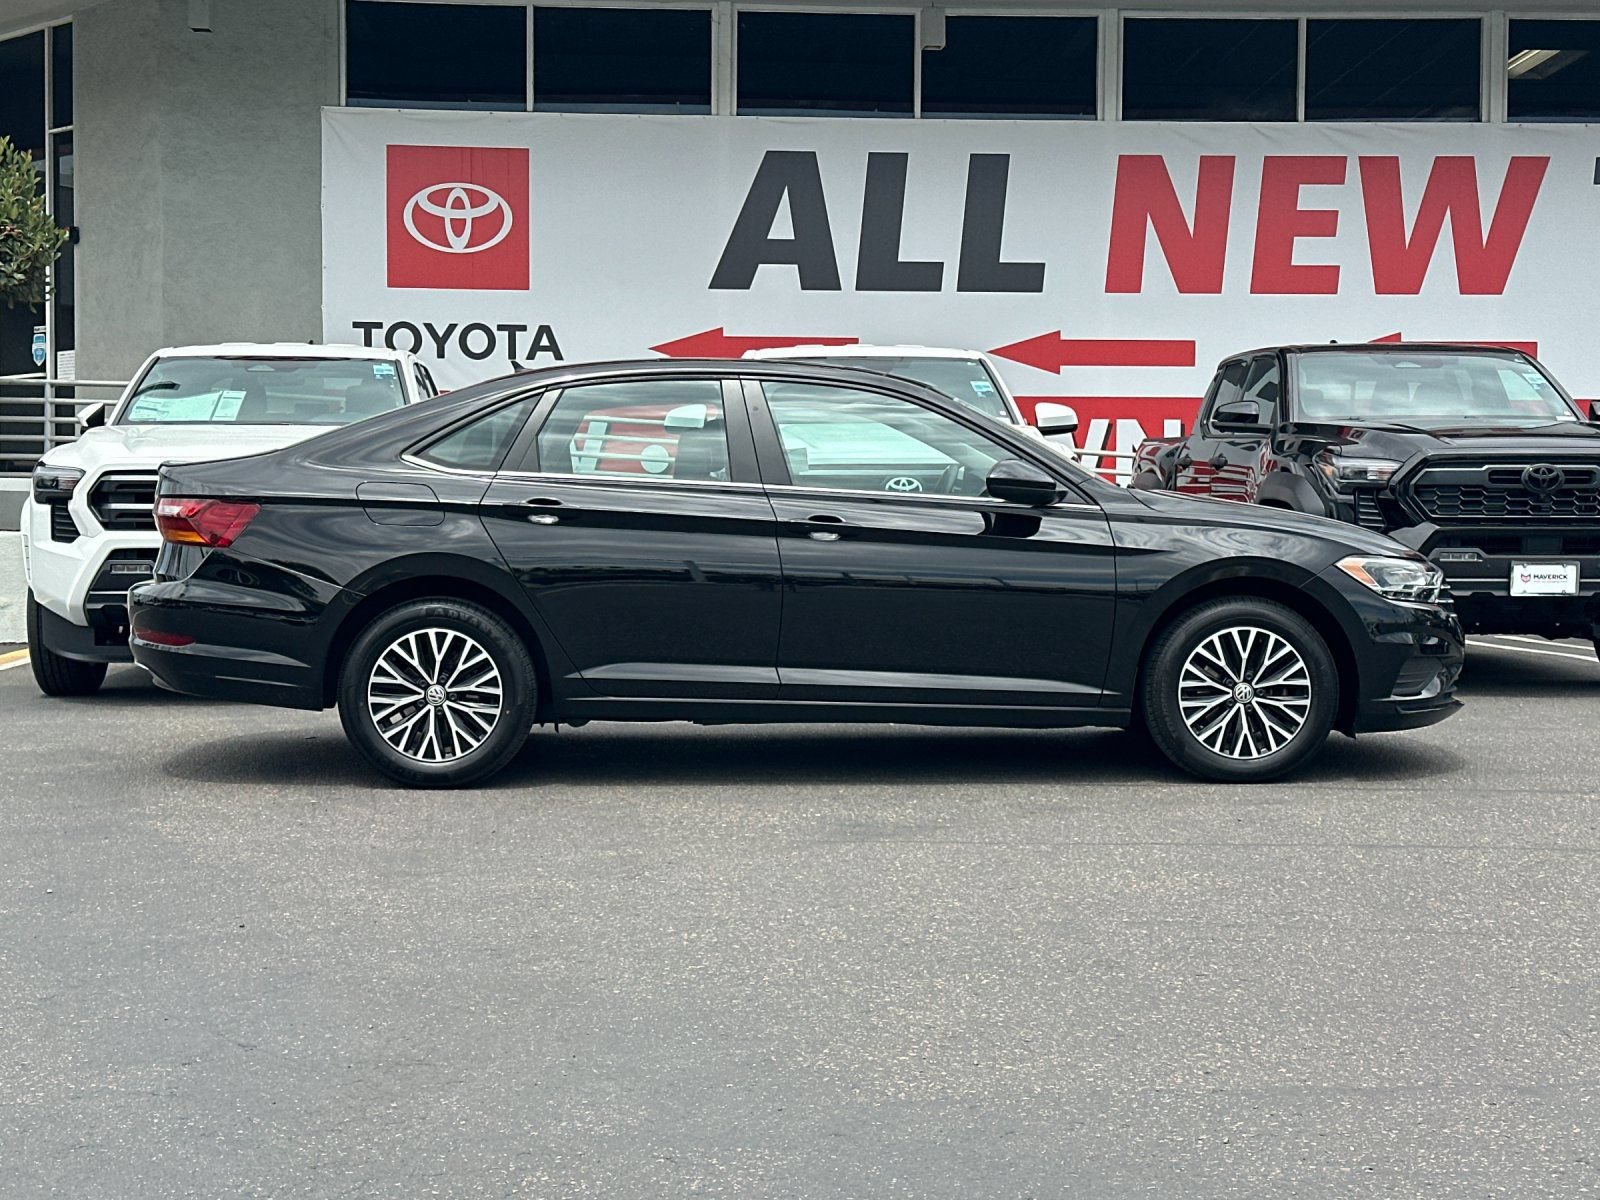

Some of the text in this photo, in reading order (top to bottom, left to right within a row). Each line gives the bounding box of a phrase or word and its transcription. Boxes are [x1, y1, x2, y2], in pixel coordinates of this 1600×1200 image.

[709, 151, 1550, 294] ALL NEW
[352, 321, 564, 361] TOYOTA
